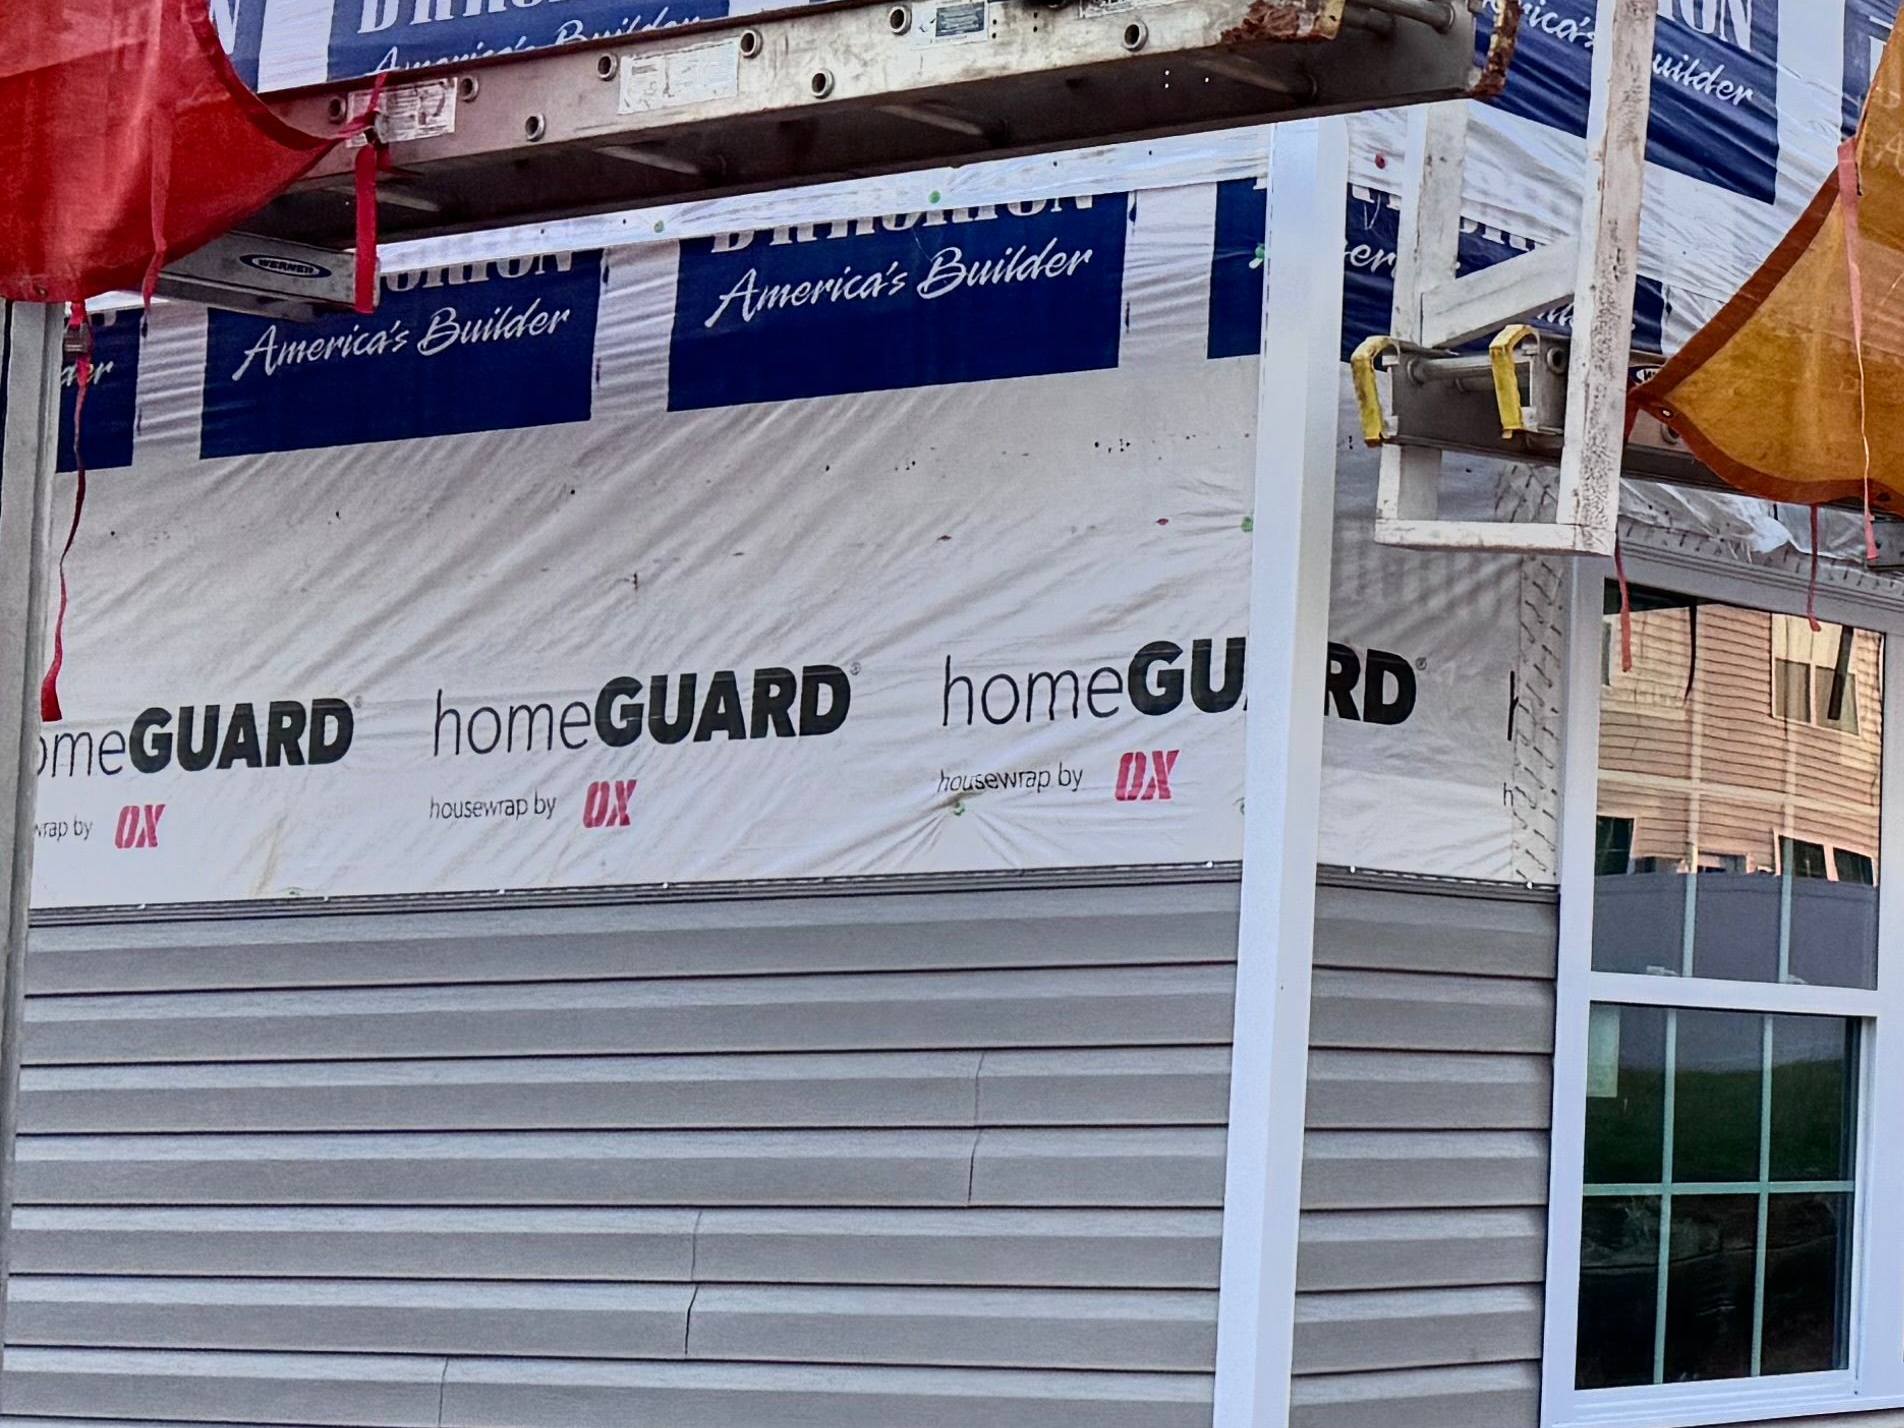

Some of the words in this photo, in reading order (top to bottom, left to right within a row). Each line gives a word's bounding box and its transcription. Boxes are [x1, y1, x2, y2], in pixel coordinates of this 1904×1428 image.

[1651, 43, 1754, 106] uilder
[704, 261, 906, 328] America's
[915, 237, 1093, 301] Builder
[231, 319, 410, 382] America's
[418, 297, 571, 356] Builder
[432, 662, 852, 758] homeGUARD
[940, 634, 1418, 728] homeGURD
[36, 696, 355, 779] meGUARD
[937, 766, 1051, 796] housewrap
[1057, 761, 1084, 793] by
[1114, 748, 1181, 803] OX
[74, 815, 93, 842] by
[113, 802, 166, 851] OX
[428, 793, 528, 825] housewrap
[533, 790, 557, 820] by
[581, 778, 638, 830] OX
